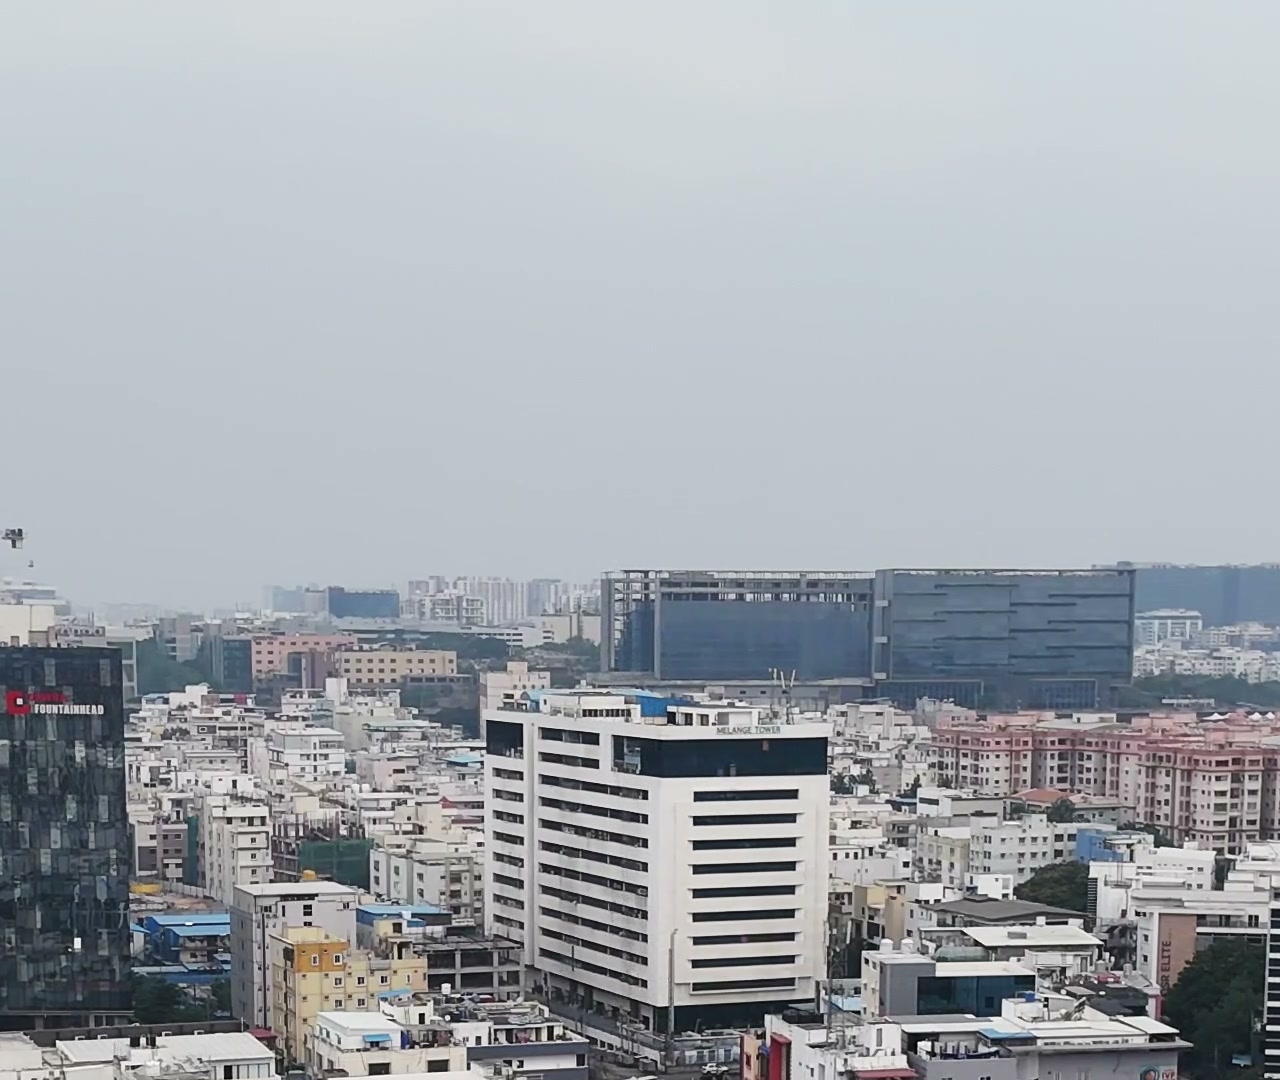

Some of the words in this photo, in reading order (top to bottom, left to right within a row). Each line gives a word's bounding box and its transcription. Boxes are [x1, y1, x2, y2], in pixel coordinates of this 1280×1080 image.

[34, 704, 105, 715] FOUNTAINHEAD
[716, 726, 752, 735] MELANGE
[755, 725, 781, 734] TOWER
[1161, 940, 1172, 972] ELITE
